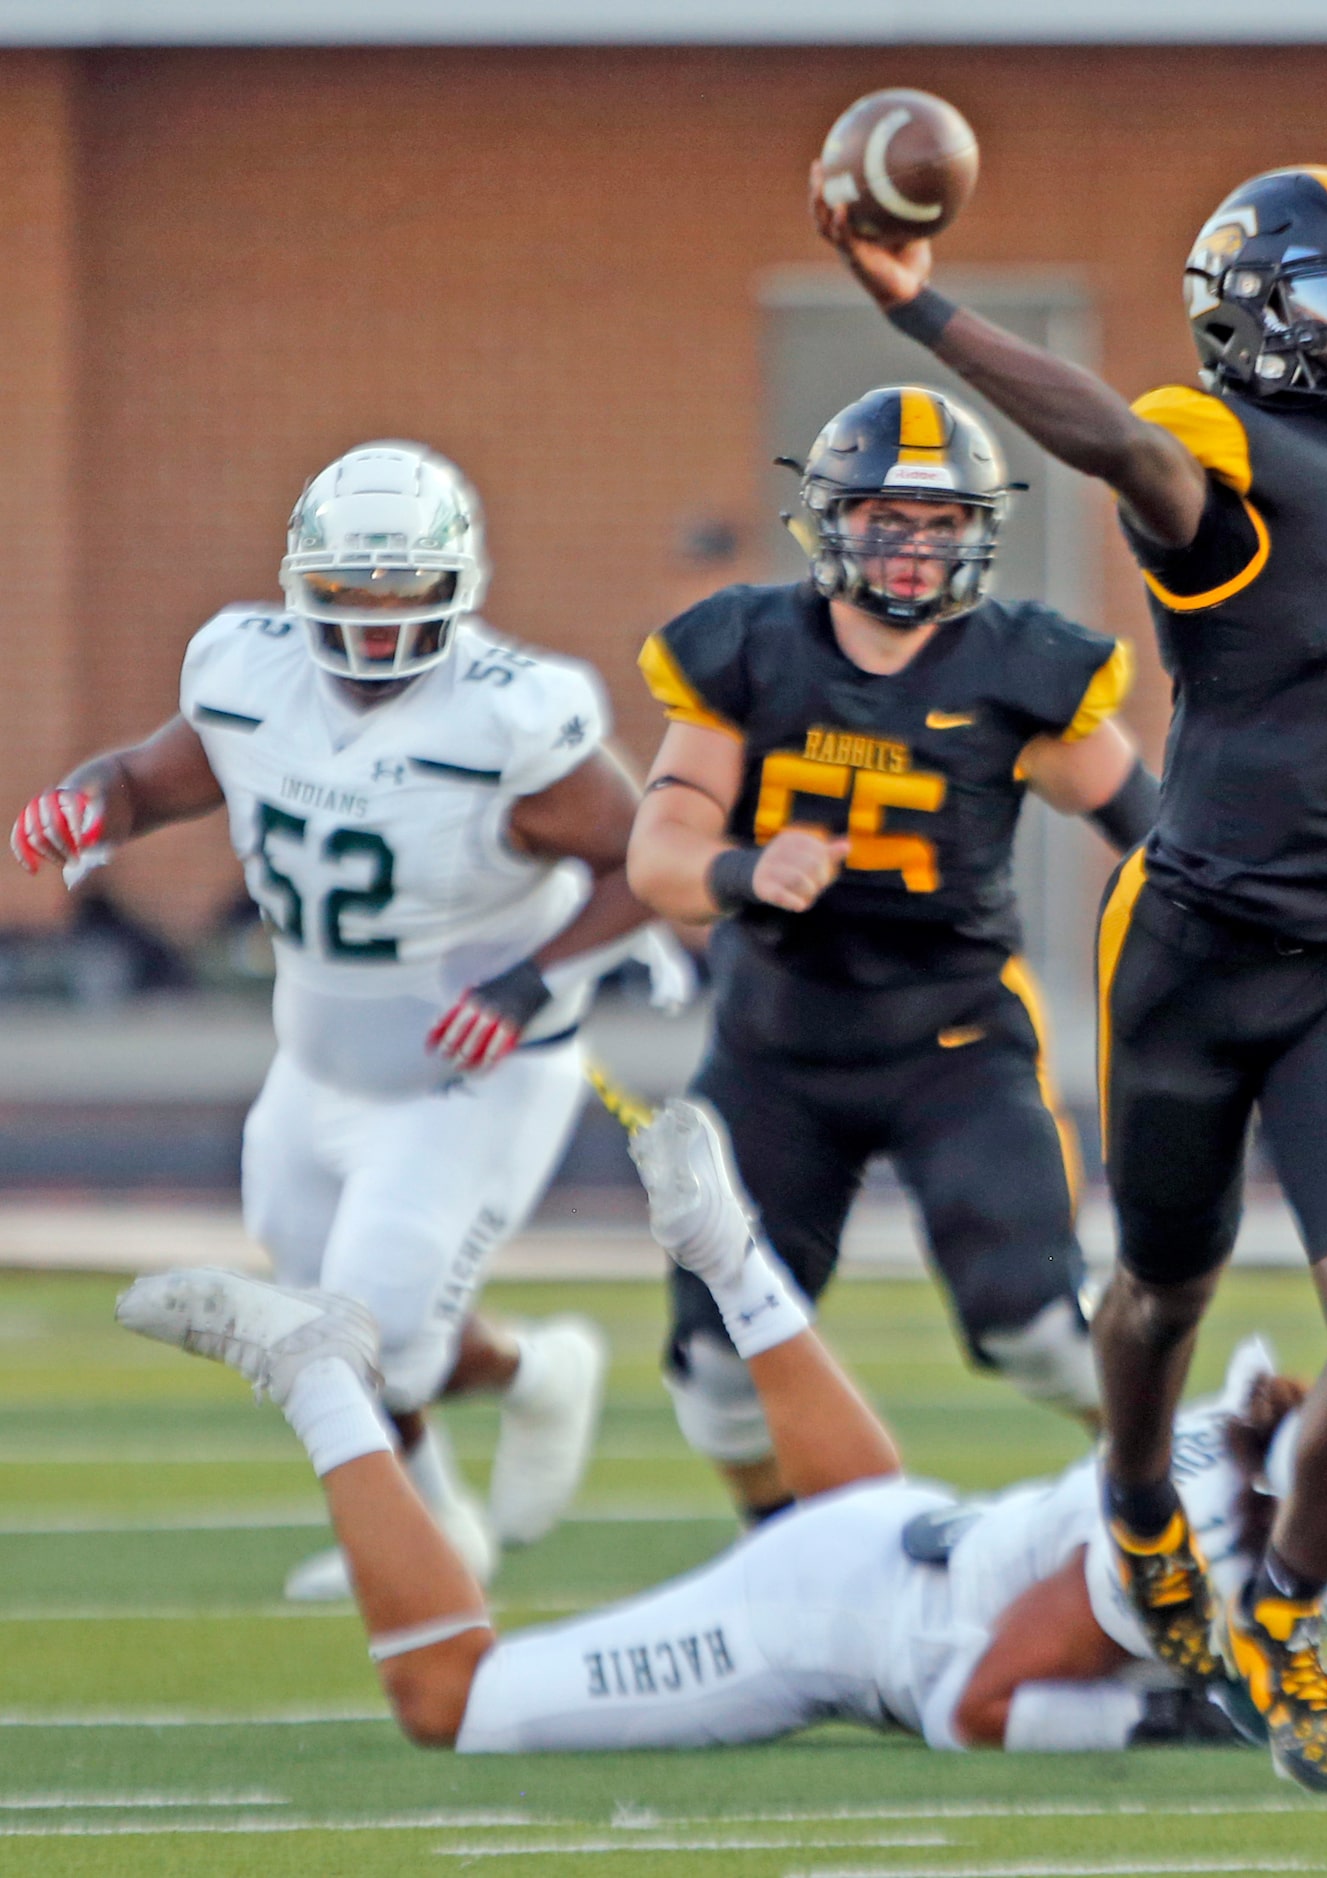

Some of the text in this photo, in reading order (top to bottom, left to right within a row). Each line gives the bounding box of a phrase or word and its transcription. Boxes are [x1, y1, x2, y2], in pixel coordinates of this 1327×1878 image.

[803, 727, 909, 773] RABBITS
[280, 776, 369, 818] INDIANS
[256, 800, 401, 962] 52
[584, 1629, 735, 1697] HACHIE
